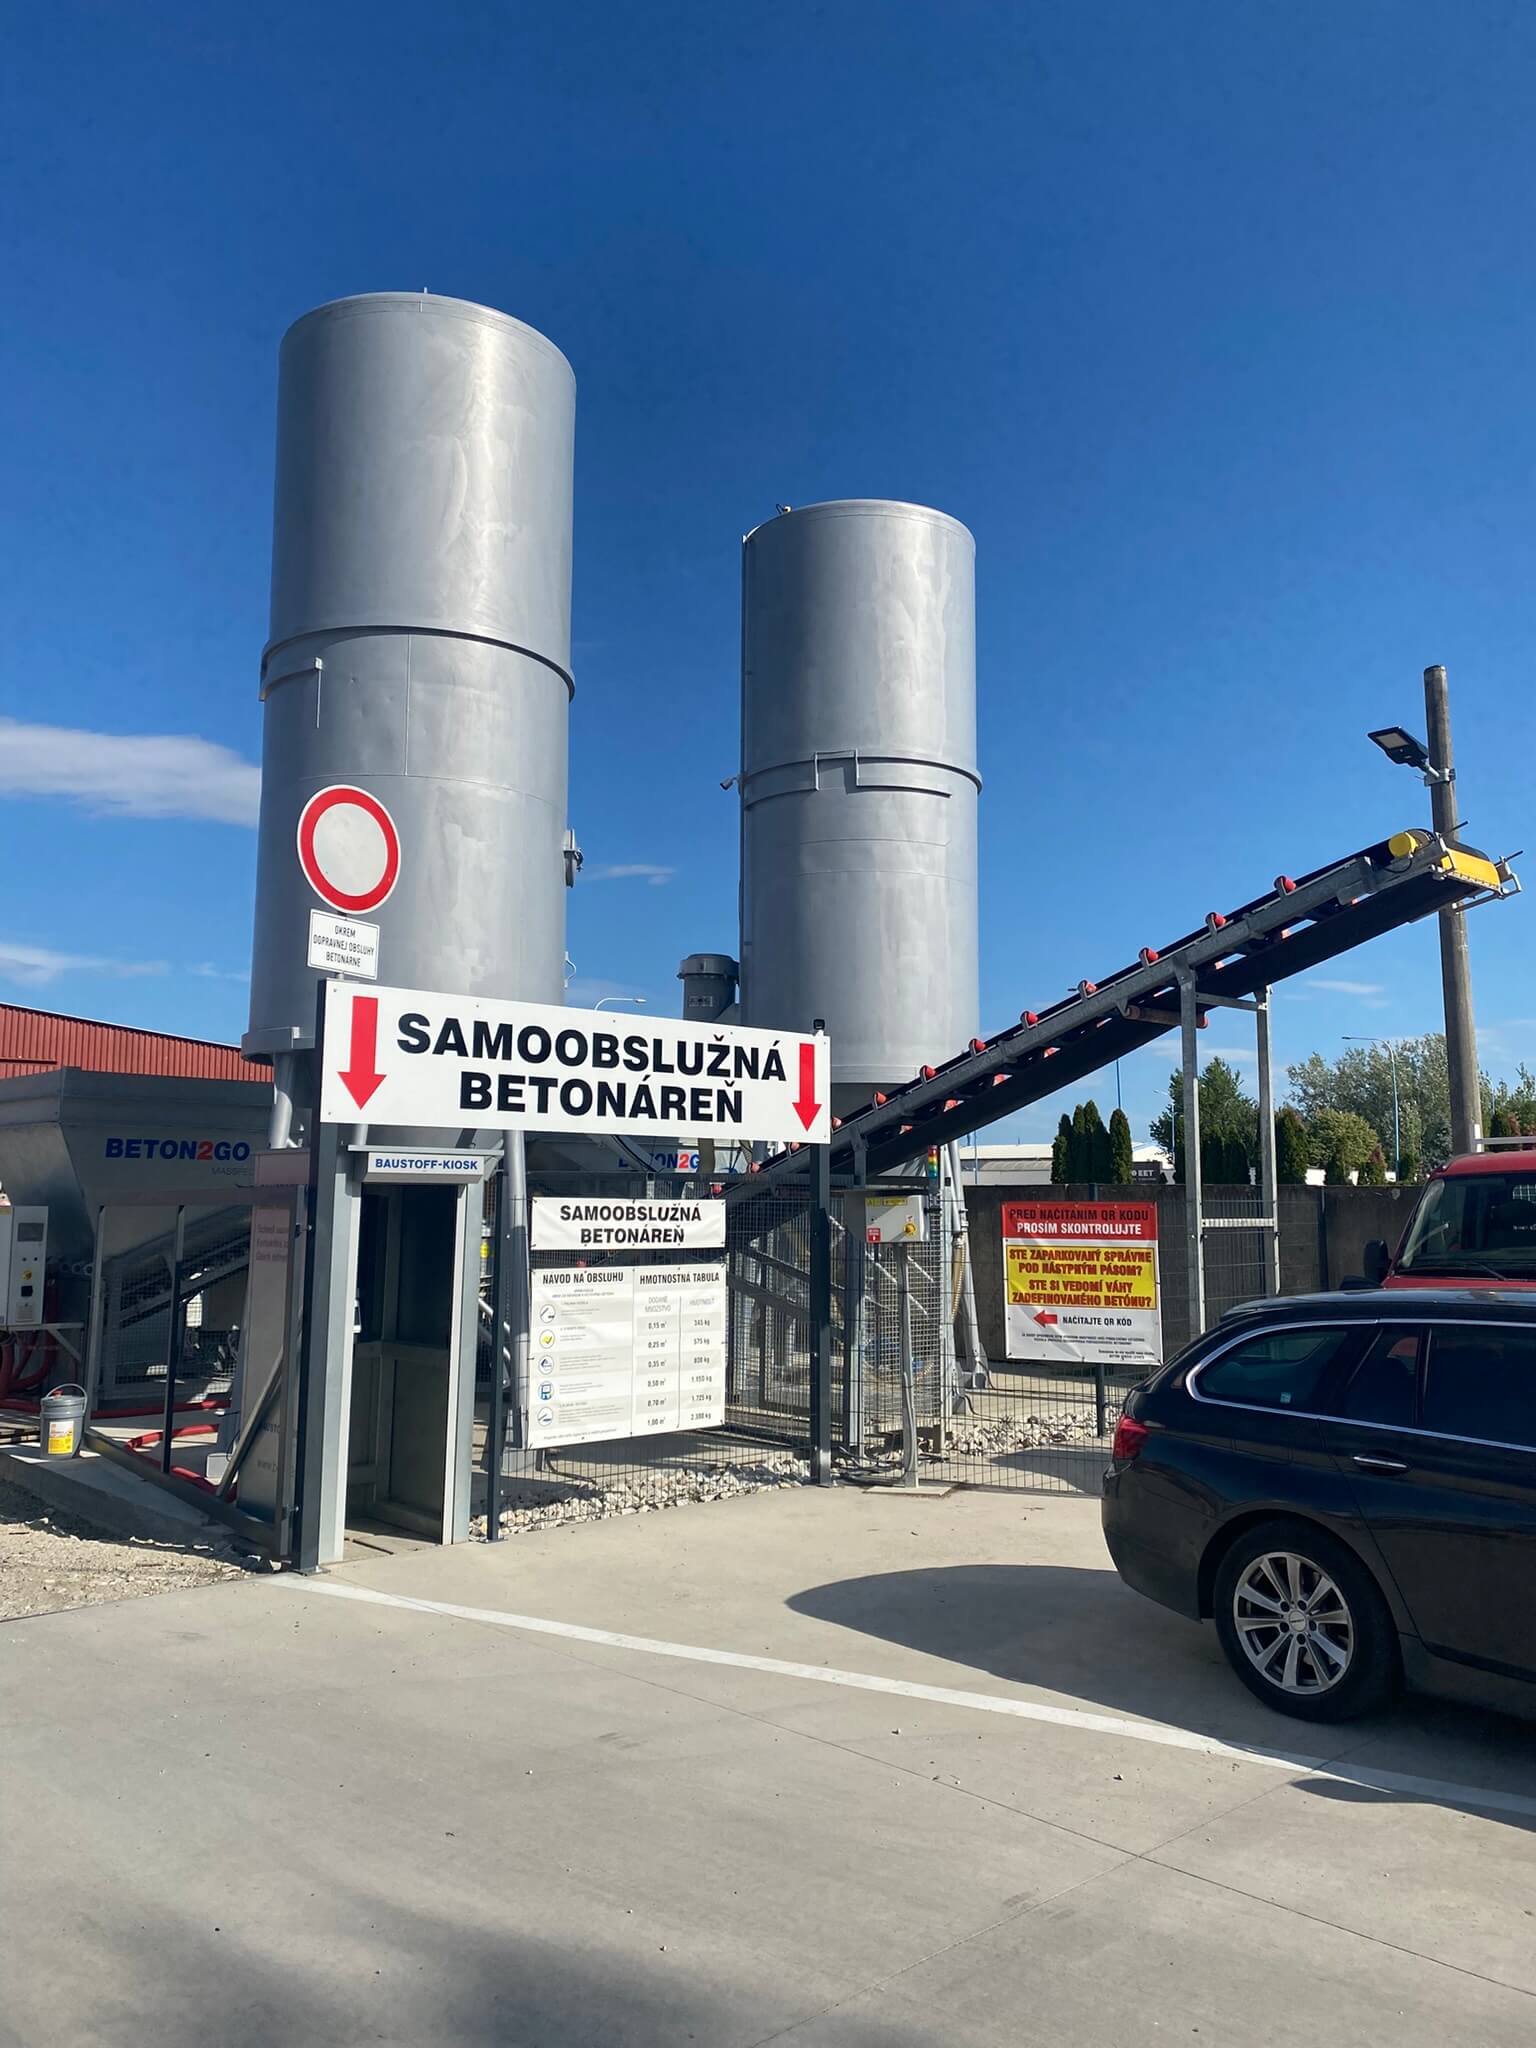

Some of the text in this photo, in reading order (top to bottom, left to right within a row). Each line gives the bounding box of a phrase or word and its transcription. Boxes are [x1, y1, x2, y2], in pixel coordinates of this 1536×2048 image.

[396, 1012, 787, 1082] SAMOOBSLUŽNÁ
[459, 1071, 743, 1124] BETONÁREŇ
[105, 1138, 250, 1162] BETON2GO
[375, 1158, 478, 1170] BAUSTOFF-KIOSK
[560, 1203, 701, 1222] SAMOOBSLUŽNÁ
[1009, 1208, 1036, 1219] PRED
[1101, 1209, 1116, 1221] QR
[580, 1224, 685, 1244] BETONÁREŇ
[1017, 1220, 1142, 1235] PROSÍM SKONTROLUJTE
[1009, 1248, 1152, 1263] STE ZAPARKOVANÝ SPRÁVNE
[1018, 1261, 1143, 1276] POD NÁSYPNÝM PÁSOM?
[573, 1273, 585, 1283] NA
[586, 1271, 624, 1283] OBSLUHU
[1029, 1279, 1133, 1294] STE SI VEDOMÍ VÁHY
[1012, 1292, 1152, 1307] ZADEFINOVANÉHO BETÓNU?
[1103, 1317, 1115, 1326] QR
